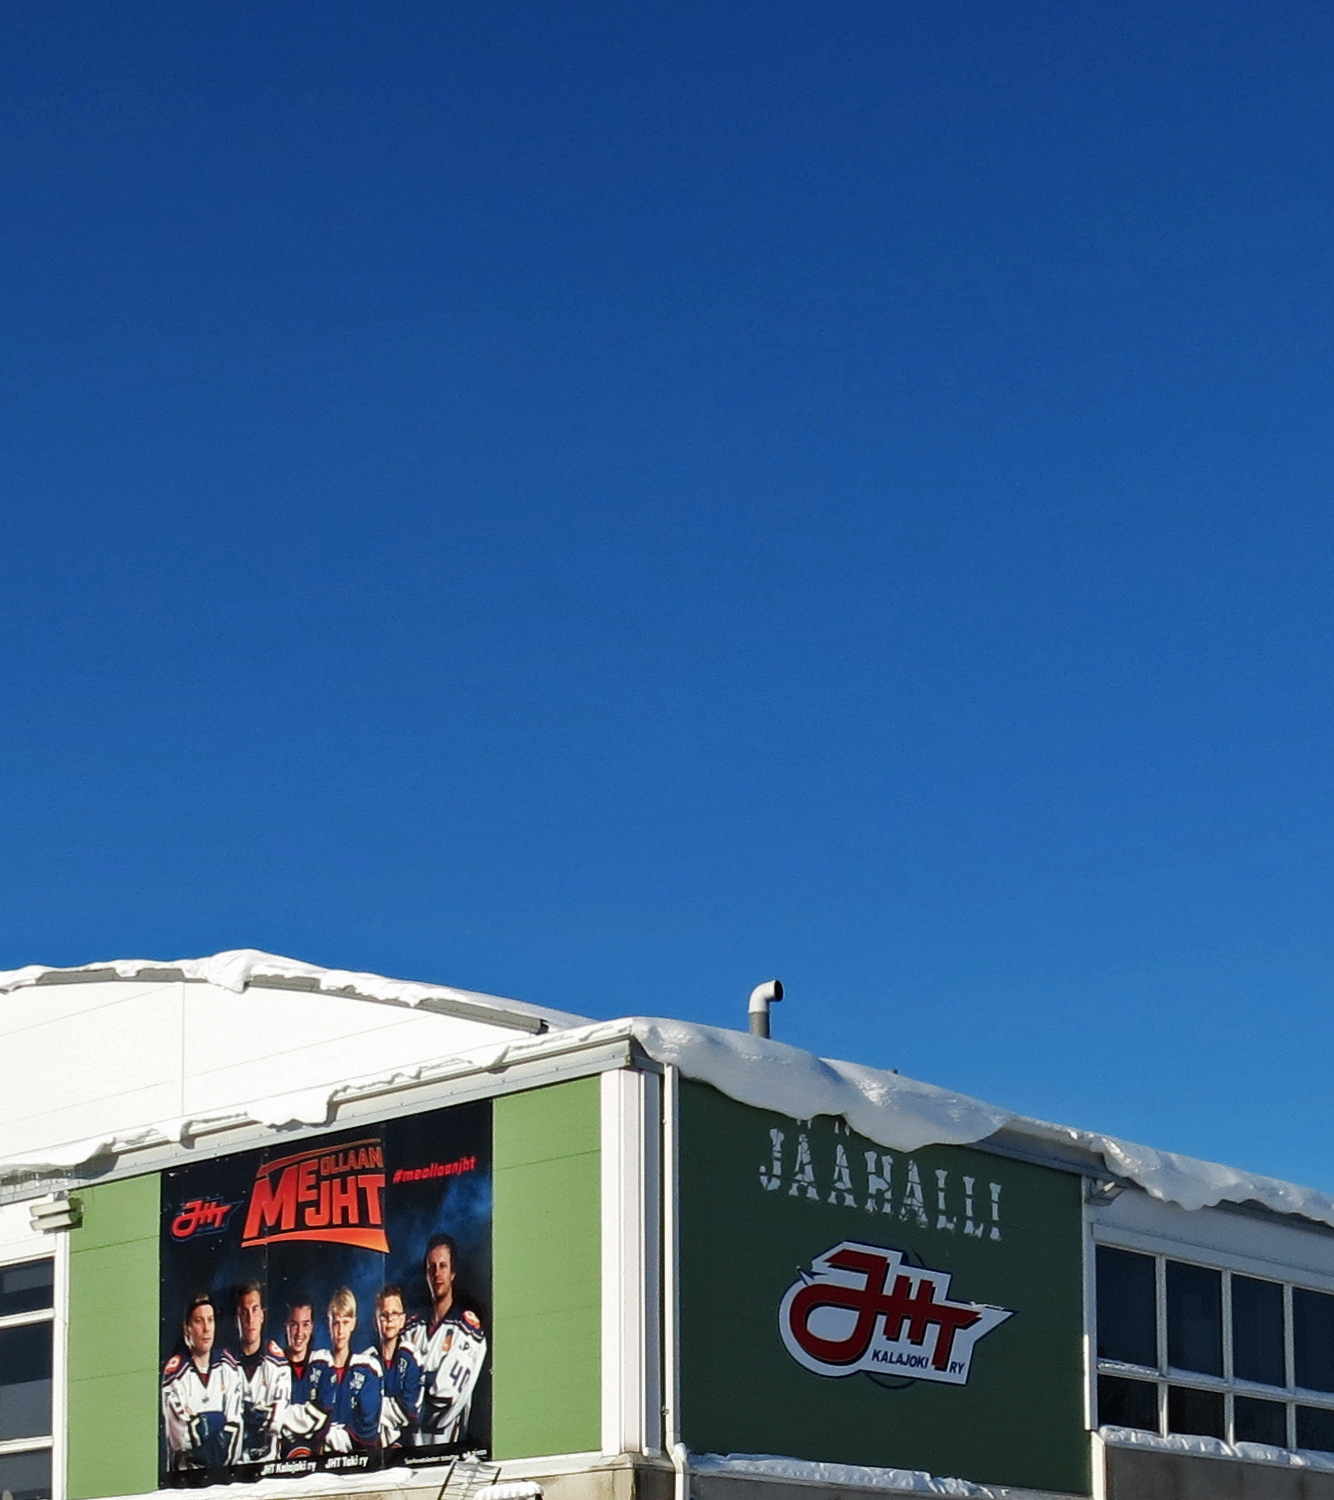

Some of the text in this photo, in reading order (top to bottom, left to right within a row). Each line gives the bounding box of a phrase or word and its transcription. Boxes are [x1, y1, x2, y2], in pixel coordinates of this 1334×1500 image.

[320, 1146, 383, 1176] OLLAAN
[305, 1174, 386, 1227] JHT
[871, 1348, 966, 1375] KALAJOKI RY
[325, 1457, 341, 1469] JHT
[359, 1456, 369, 1467] ry
